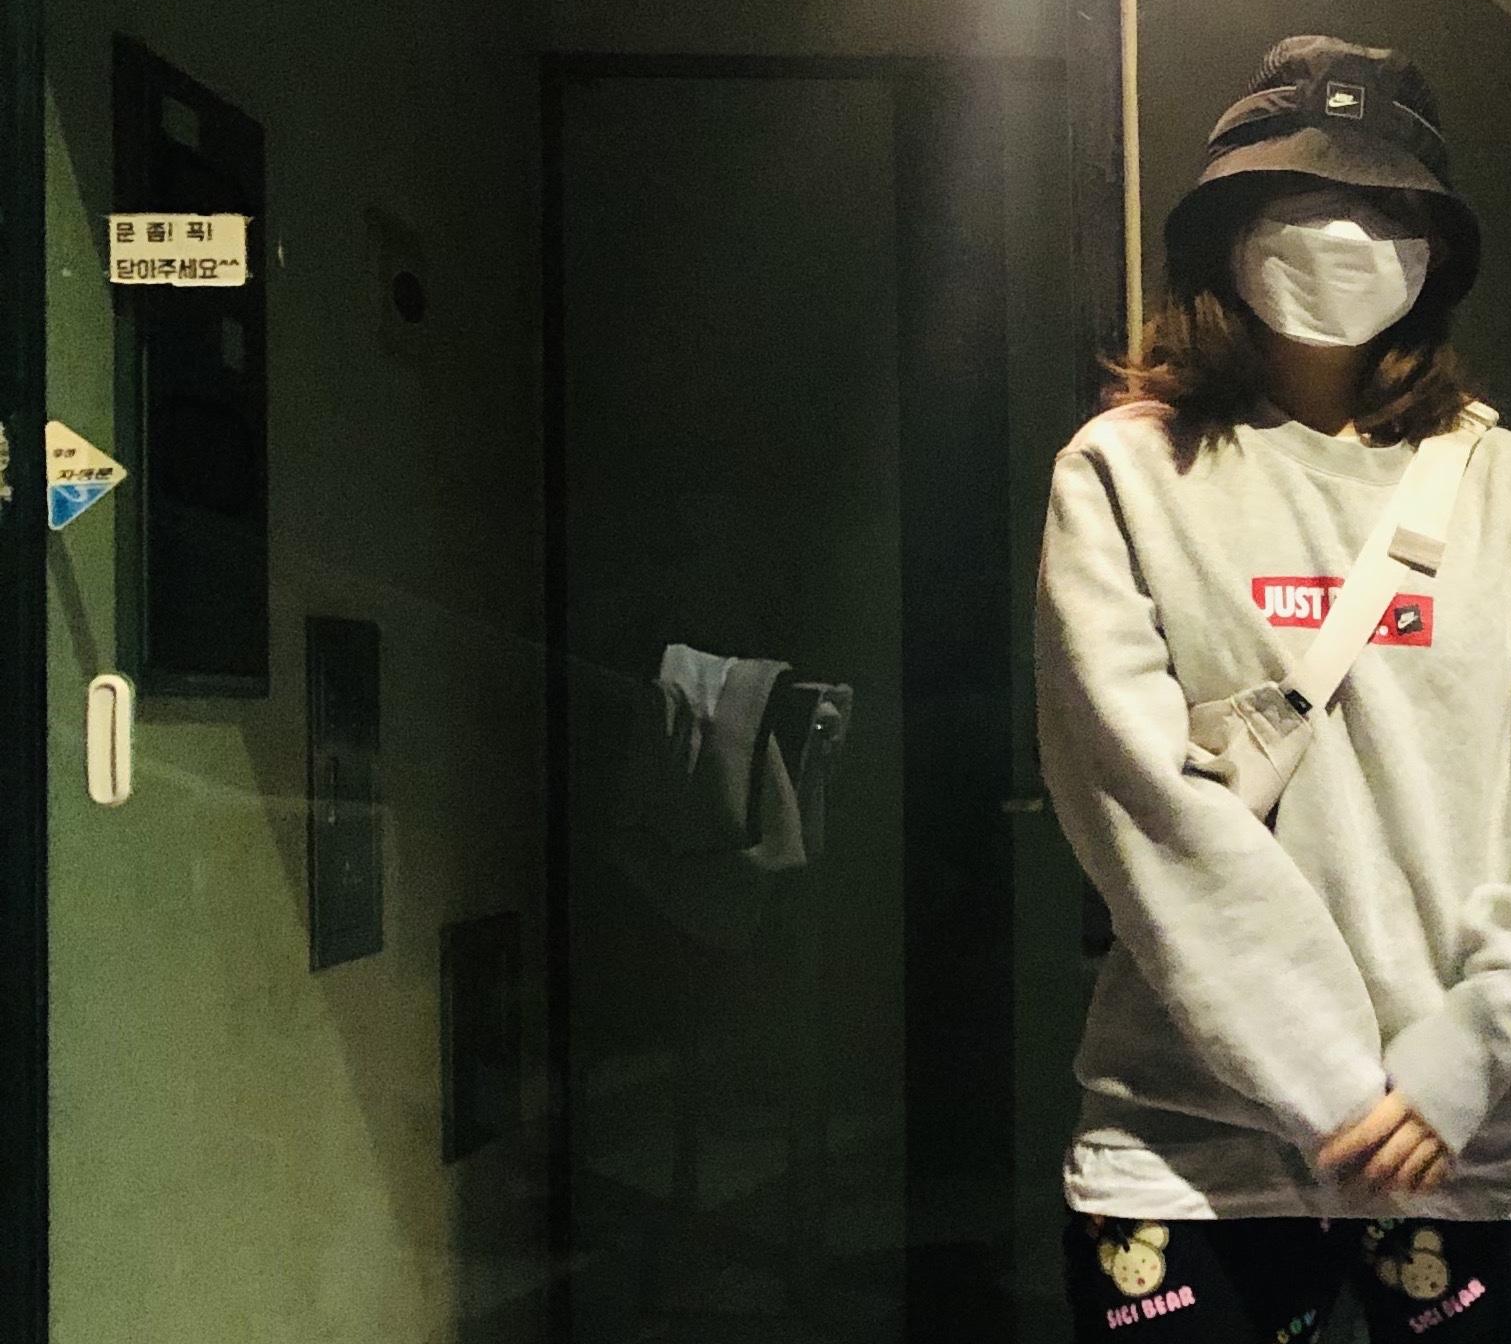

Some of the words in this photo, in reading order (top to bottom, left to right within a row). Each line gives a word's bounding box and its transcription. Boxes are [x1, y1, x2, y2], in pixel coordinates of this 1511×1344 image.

[116, 222, 135, 243] 문
[1254, 585, 1325, 620] JUST
[1141, 1284, 1196, 1319] BEAR
